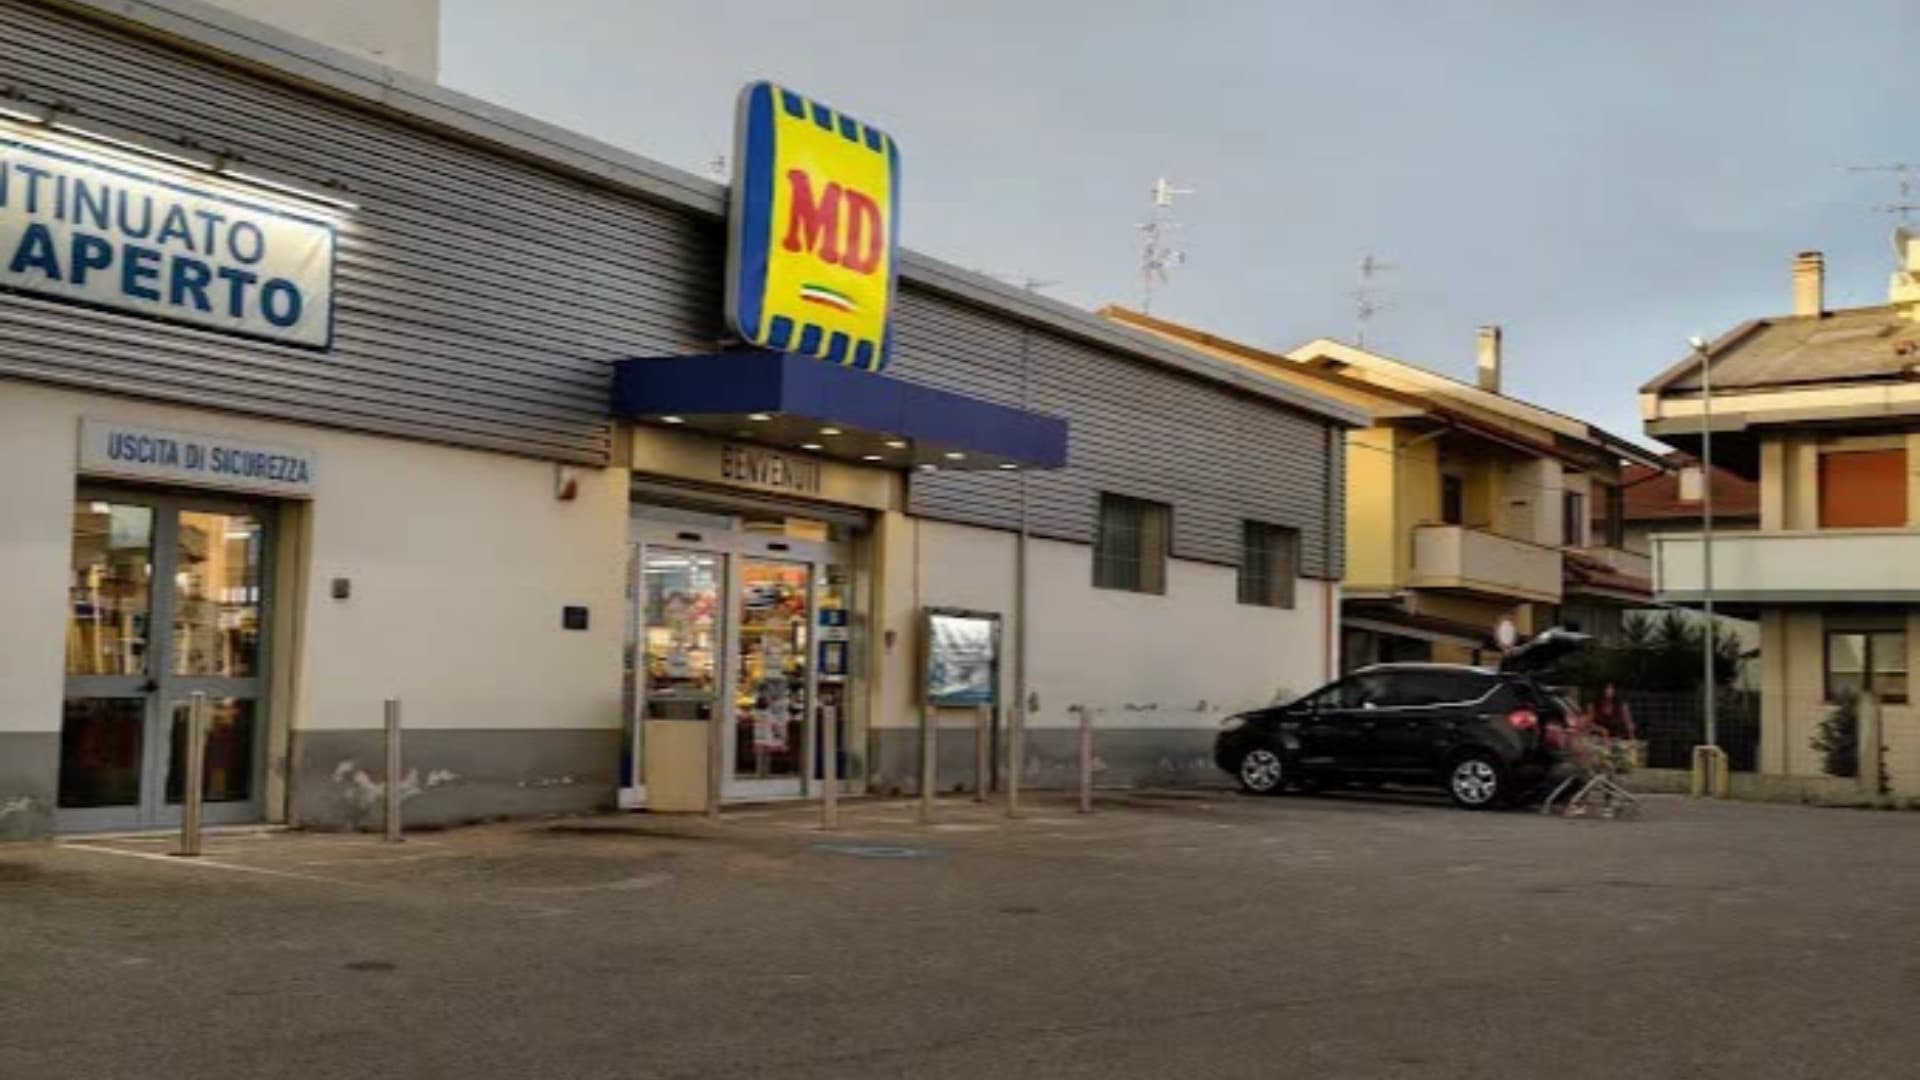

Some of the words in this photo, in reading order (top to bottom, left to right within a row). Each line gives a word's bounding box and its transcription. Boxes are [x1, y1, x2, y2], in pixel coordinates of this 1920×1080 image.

[782, 168, 882, 275] MD
[10, 223, 303, 327] APERTO
[107, 432, 178, 467] USCITA
[185, 444, 204, 470] DI
[211, 448, 308, 482] SICUREZZA
